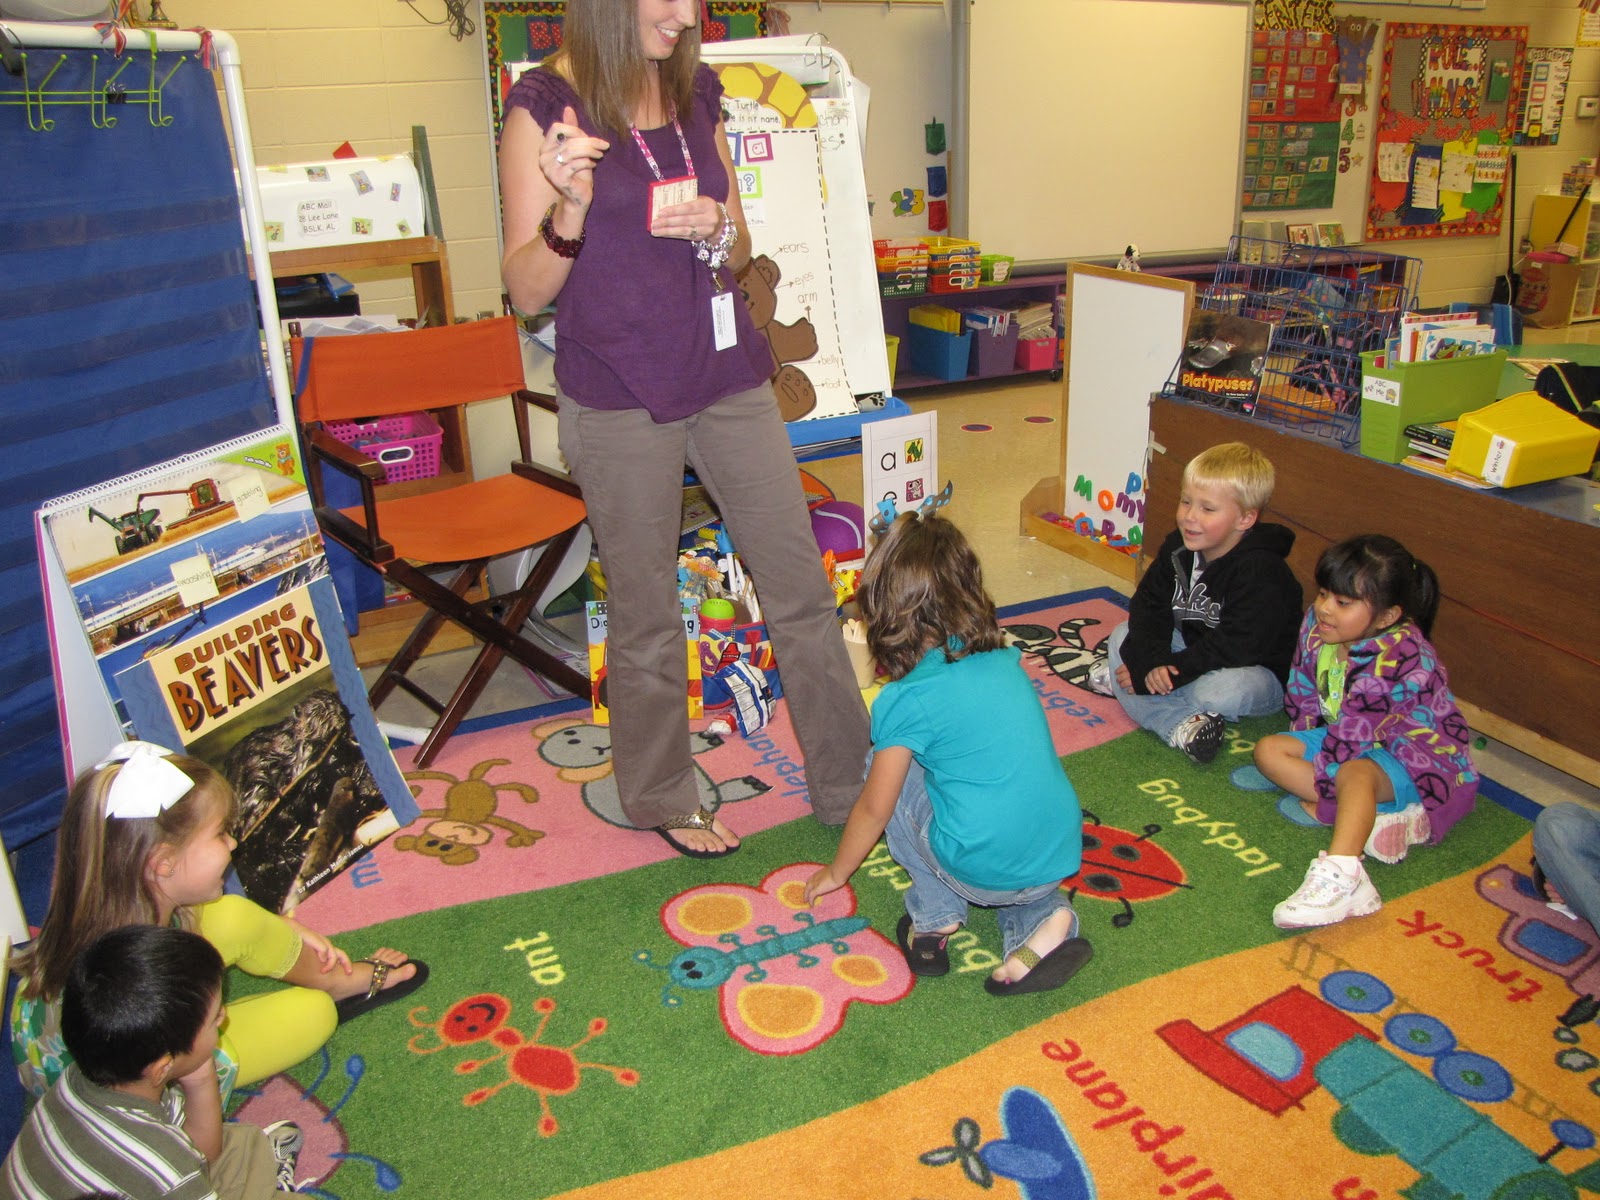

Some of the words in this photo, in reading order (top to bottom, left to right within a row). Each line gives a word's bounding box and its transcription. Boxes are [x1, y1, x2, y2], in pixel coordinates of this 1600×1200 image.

[735, 99, 759, 110] Turtle
[760, 115, 781, 124] name.
[1341, 118, 1355, 145] 4
[1338, 147, 1350, 173] 5
[301, 203, 315, 211] ABC
[317, 201, 332, 209] Mail
[308, 214, 321, 222] Lee
[323, 212, 339, 220] Lane
[783, 241, 810, 254] ears
[794, 272, 815, 286] eyes
[797, 291, 818, 304] arm
[820, 356, 840, 369] belly
[1182, 373, 1255, 392] Platypuses
[1375, 380, 1387, 388] ABC
[881, 452, 896, 471] a
[1490, 451, 1502, 473] Winter
[177, 570, 212, 586] swooshing
[174, 602, 297, 674] BUILDING
[168, 614, 323, 733] BEAVERS
[743, 731, 810, 802] lephan
[1137, 778, 1282, 877] ladybug
[297, 884, 306, 894] by
[305, 866, 331, 887] Kathleen
[504, 931, 568, 985] ant
[1396, 909, 1543, 1003] truck
